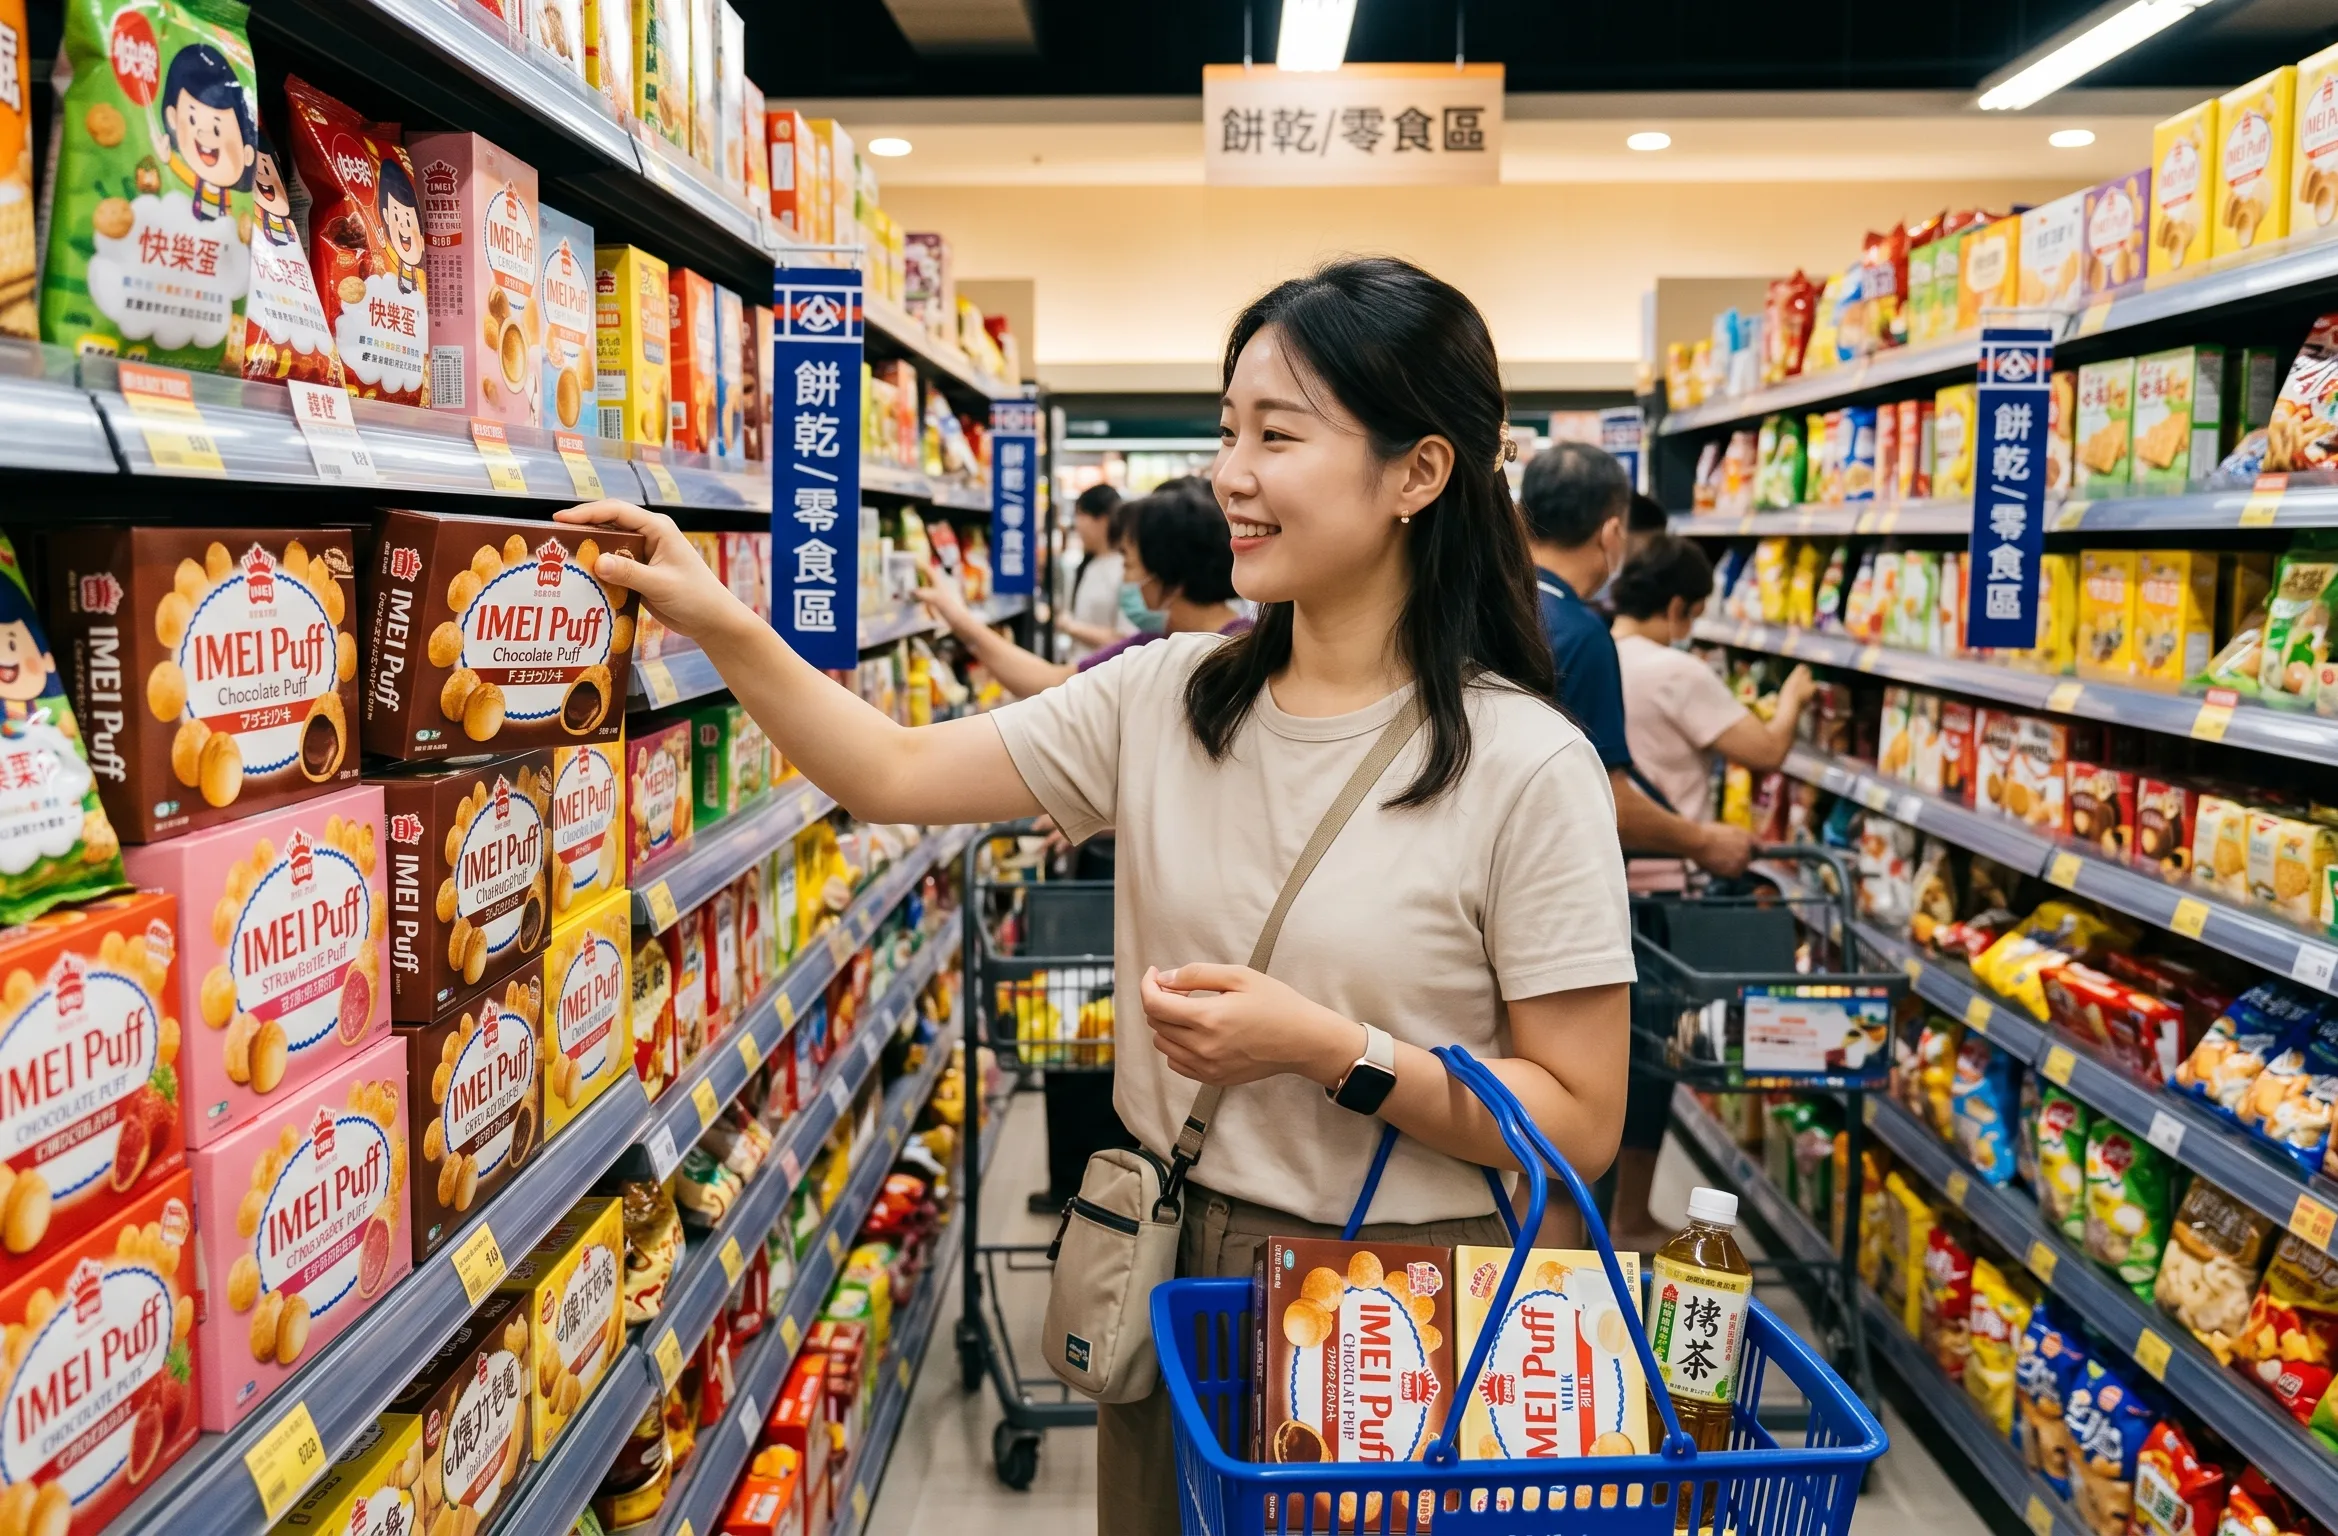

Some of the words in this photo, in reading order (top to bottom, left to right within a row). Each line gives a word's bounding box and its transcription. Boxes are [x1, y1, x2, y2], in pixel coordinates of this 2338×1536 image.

[1221, 105, 1485, 157] 餅乾/零食區
[139, 226, 221, 277] 快樂蛋
[489, 220, 515, 255] IMEI
[517, 230, 534, 265] Puff
[369, 296, 416, 338] 快樂蛋
[546, 278, 569, 310] IMEI
[569, 290, 588, 316] Puff
[793, 360, 840, 633] 餅乾/零食區
[1985, 402, 2033, 620] 餅乾/零食區
[194, 630, 264, 682] IMEI
[270, 622, 326, 677] Puff
[385, 588, 413, 650] IMEI
[476, 605, 543, 641] IMEI
[549, 607, 605, 648] Puff
[88, 626, 121, 701] IMEI
[374, 653, 405, 712] Puff
[493, 647, 553, 662] Chocolate
[557, 647, 582, 664] Puff
[217, 683, 280, 706] Chocolate
[283, 676, 308, 696] Puff
[92, 711, 126, 782] Puff
[555, 789, 584, 831] IMEI
[588, 777, 614, 816] Puff
[395, 854, 420, 913] IMEI
[464, 838, 503, 890] IMEI
[507, 823, 539, 871] Puff
[243, 908, 306, 977] IMEI
[312, 884, 361, 947] Puff
[393, 920, 419, 975] Puff
[562, 981, 592, 1031] IMEI
[595, 961, 620, 1007] Puff
[84, 1007, 145, 1080] Puff
[453, 1063, 493, 1123] IMEI
[497, 1035, 529, 1091] Puff
[269, 1179, 328, 1258] IMEI
[334, 1140, 382, 1212] Puff
[17, 1348, 92, 1444] IMEI
[101, 1292, 162, 1380] Puff
[1360, 1304, 1392, 1383] IMEI
[1521, 1304, 1556, 1379] Puff
[1358, 1394, 1395, 1463] Puf
[1524, 1390, 1559, 1459] MEI
